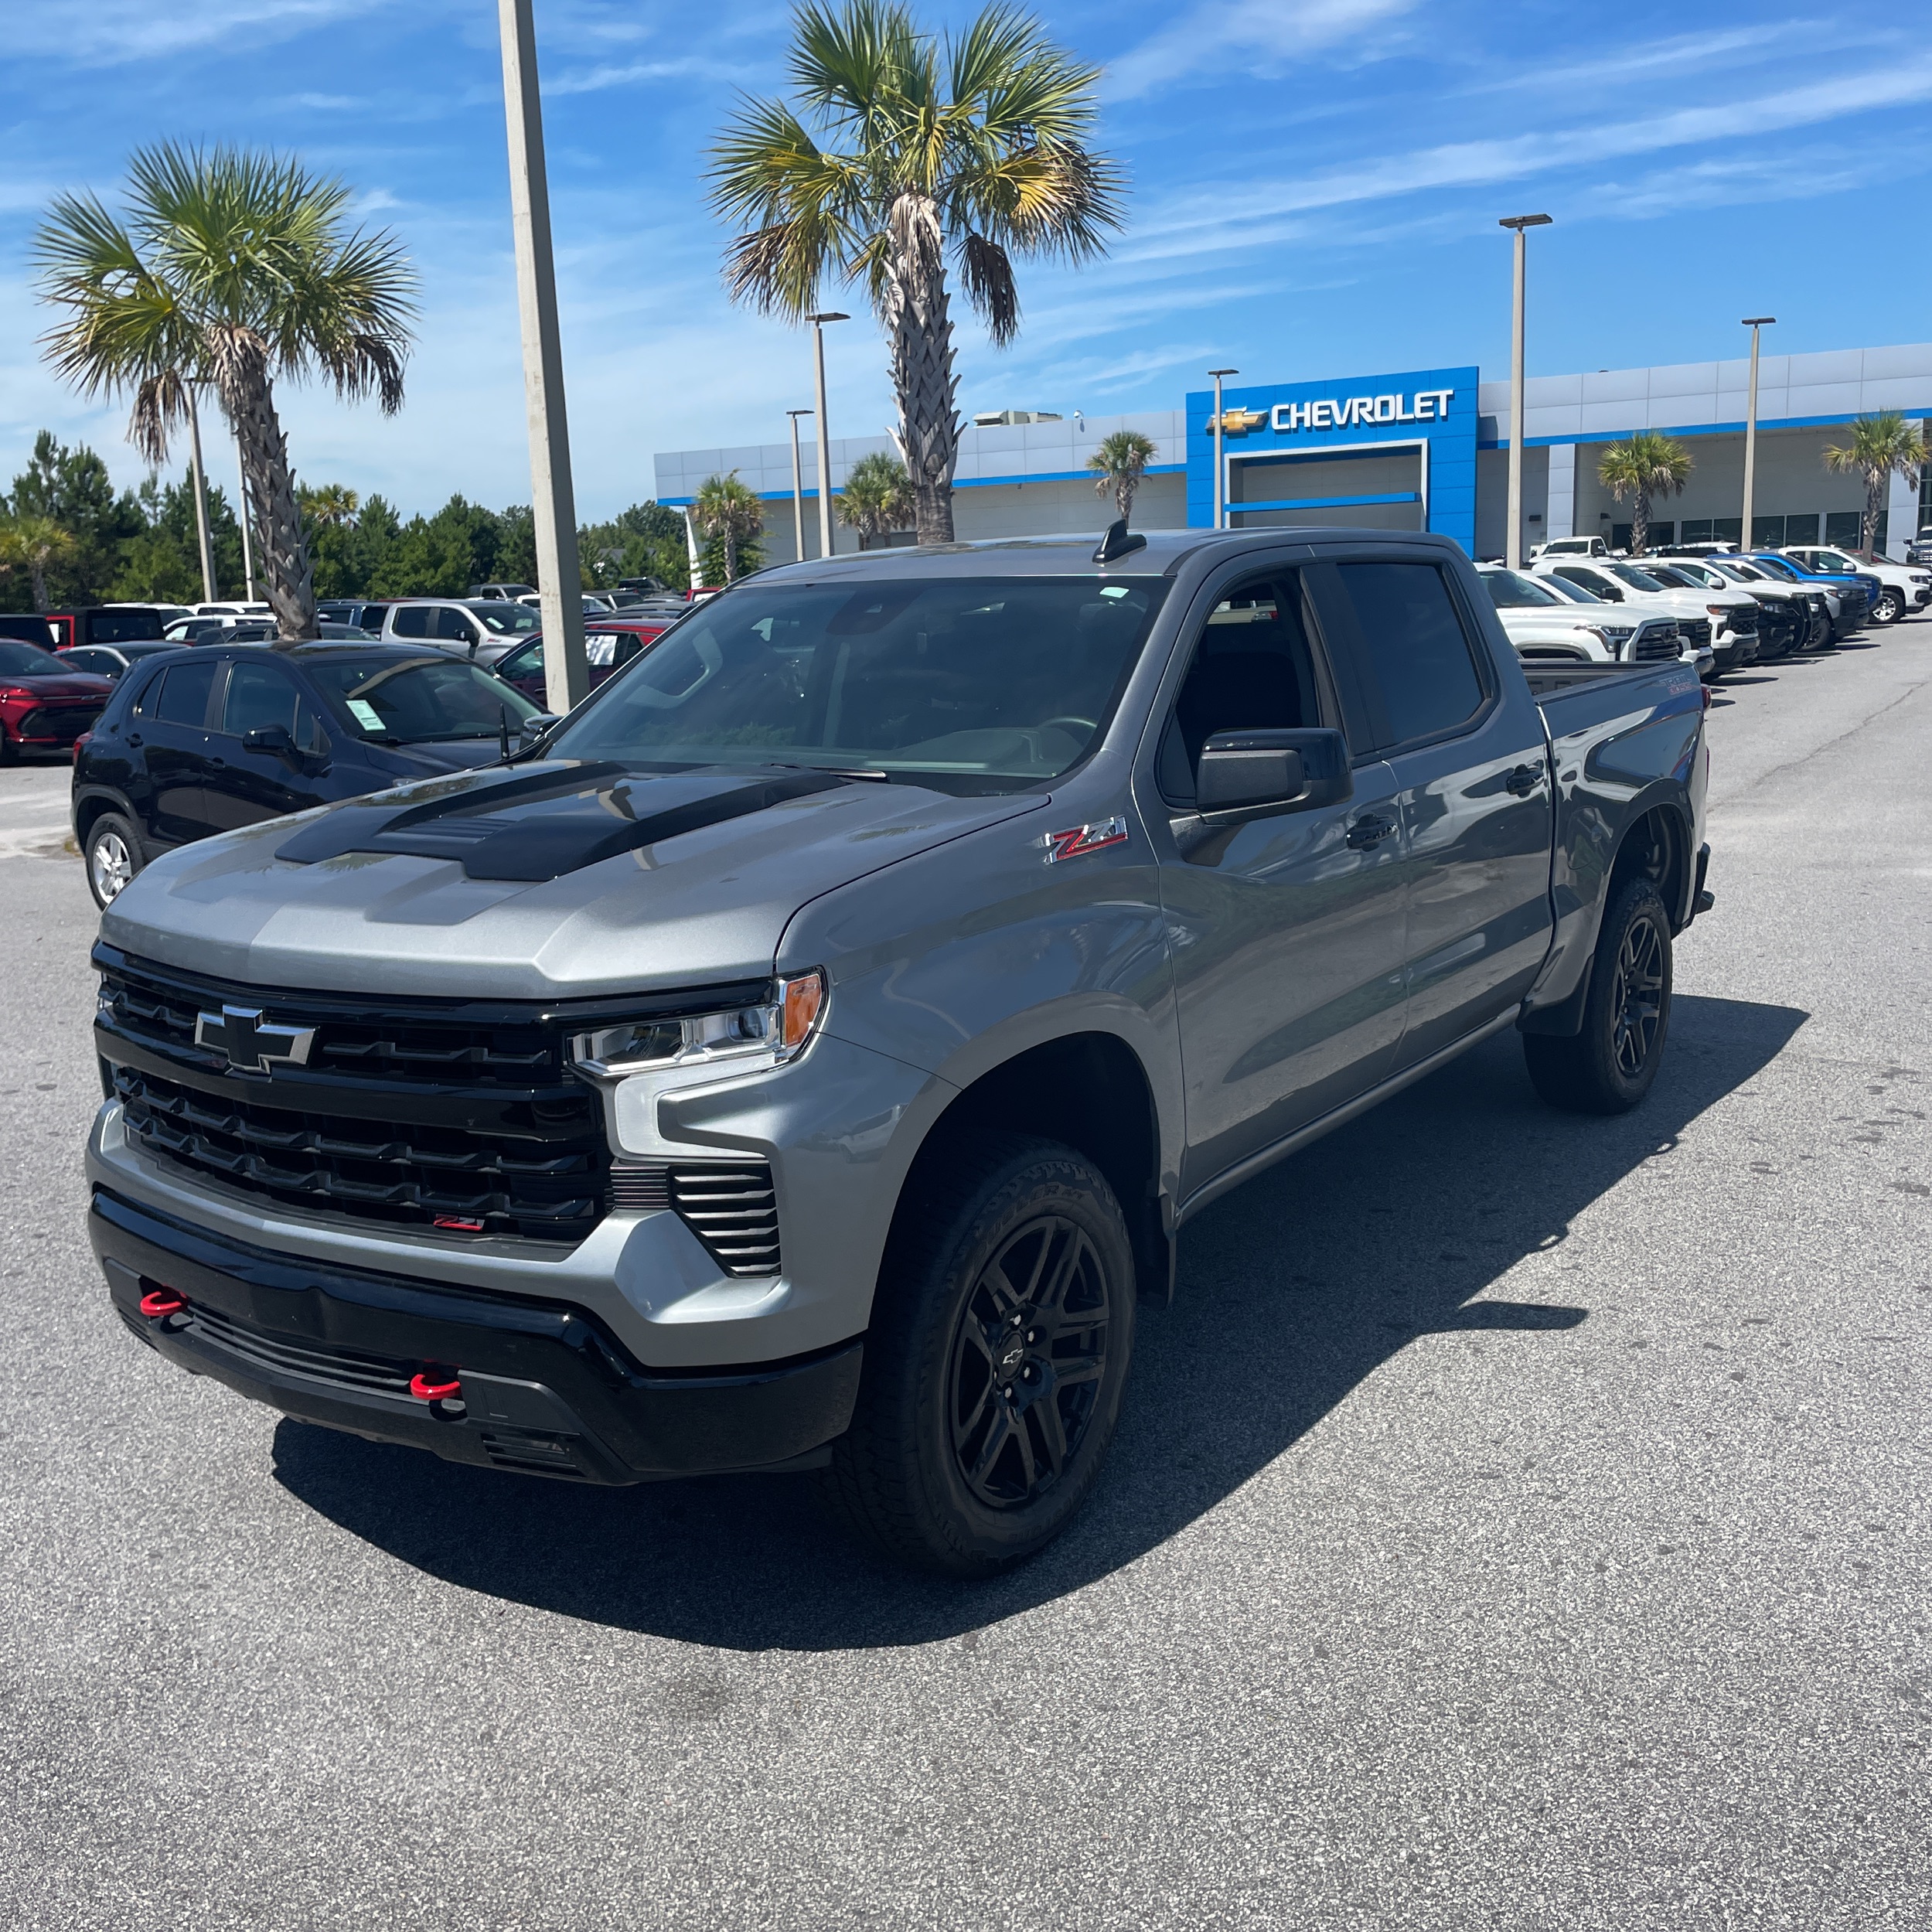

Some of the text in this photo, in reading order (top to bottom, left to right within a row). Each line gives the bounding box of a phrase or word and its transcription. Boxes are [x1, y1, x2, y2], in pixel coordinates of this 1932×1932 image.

[1271, 389, 1453, 431] CHEVROLET
[1659, 673, 1692, 688] TRAIL
[1668, 682, 1692, 696] BOSS
[1044, 815, 1128, 864] Z71
[433, 1213, 485, 1231] Z71
